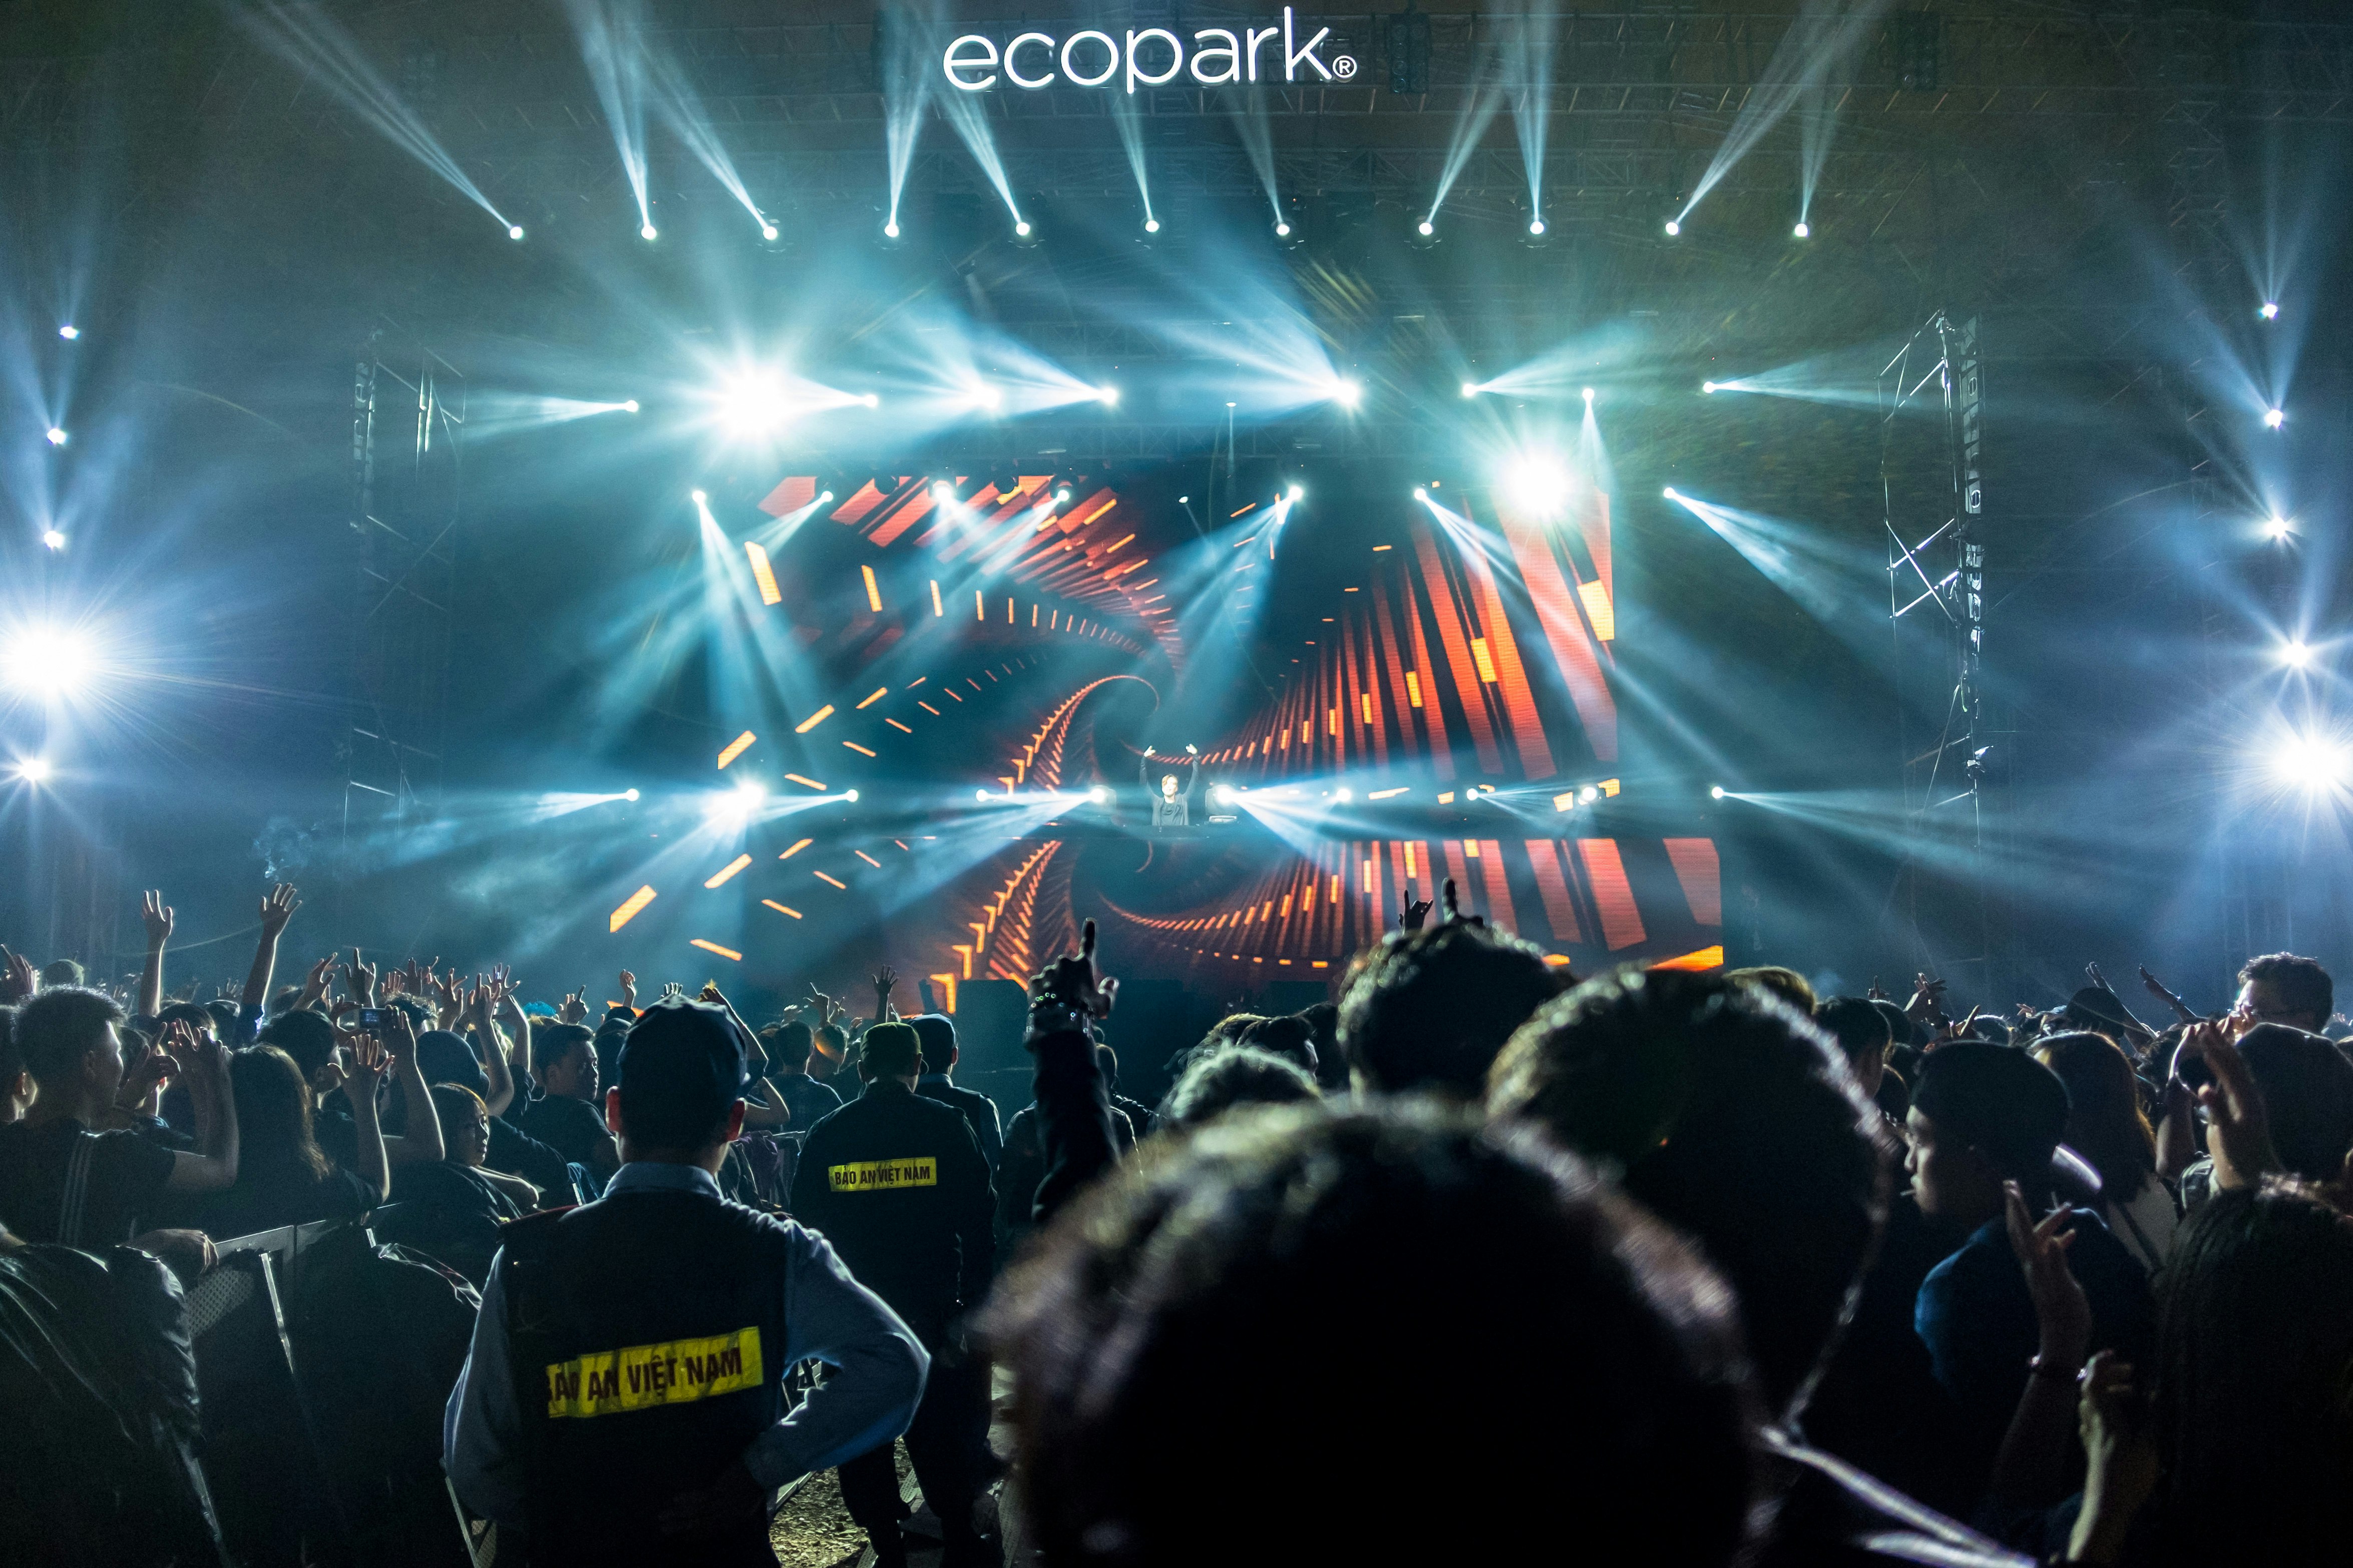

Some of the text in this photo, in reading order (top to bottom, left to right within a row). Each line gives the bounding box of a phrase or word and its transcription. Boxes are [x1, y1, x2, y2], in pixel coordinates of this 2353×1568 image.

[860, 1170, 876, 1184] AN
[904, 1166, 930, 1180] NAM
[588, 1368, 620, 1401] AN
[627, 1355, 678, 1396] VIỆT
[685, 1347, 742, 1385] NAM
